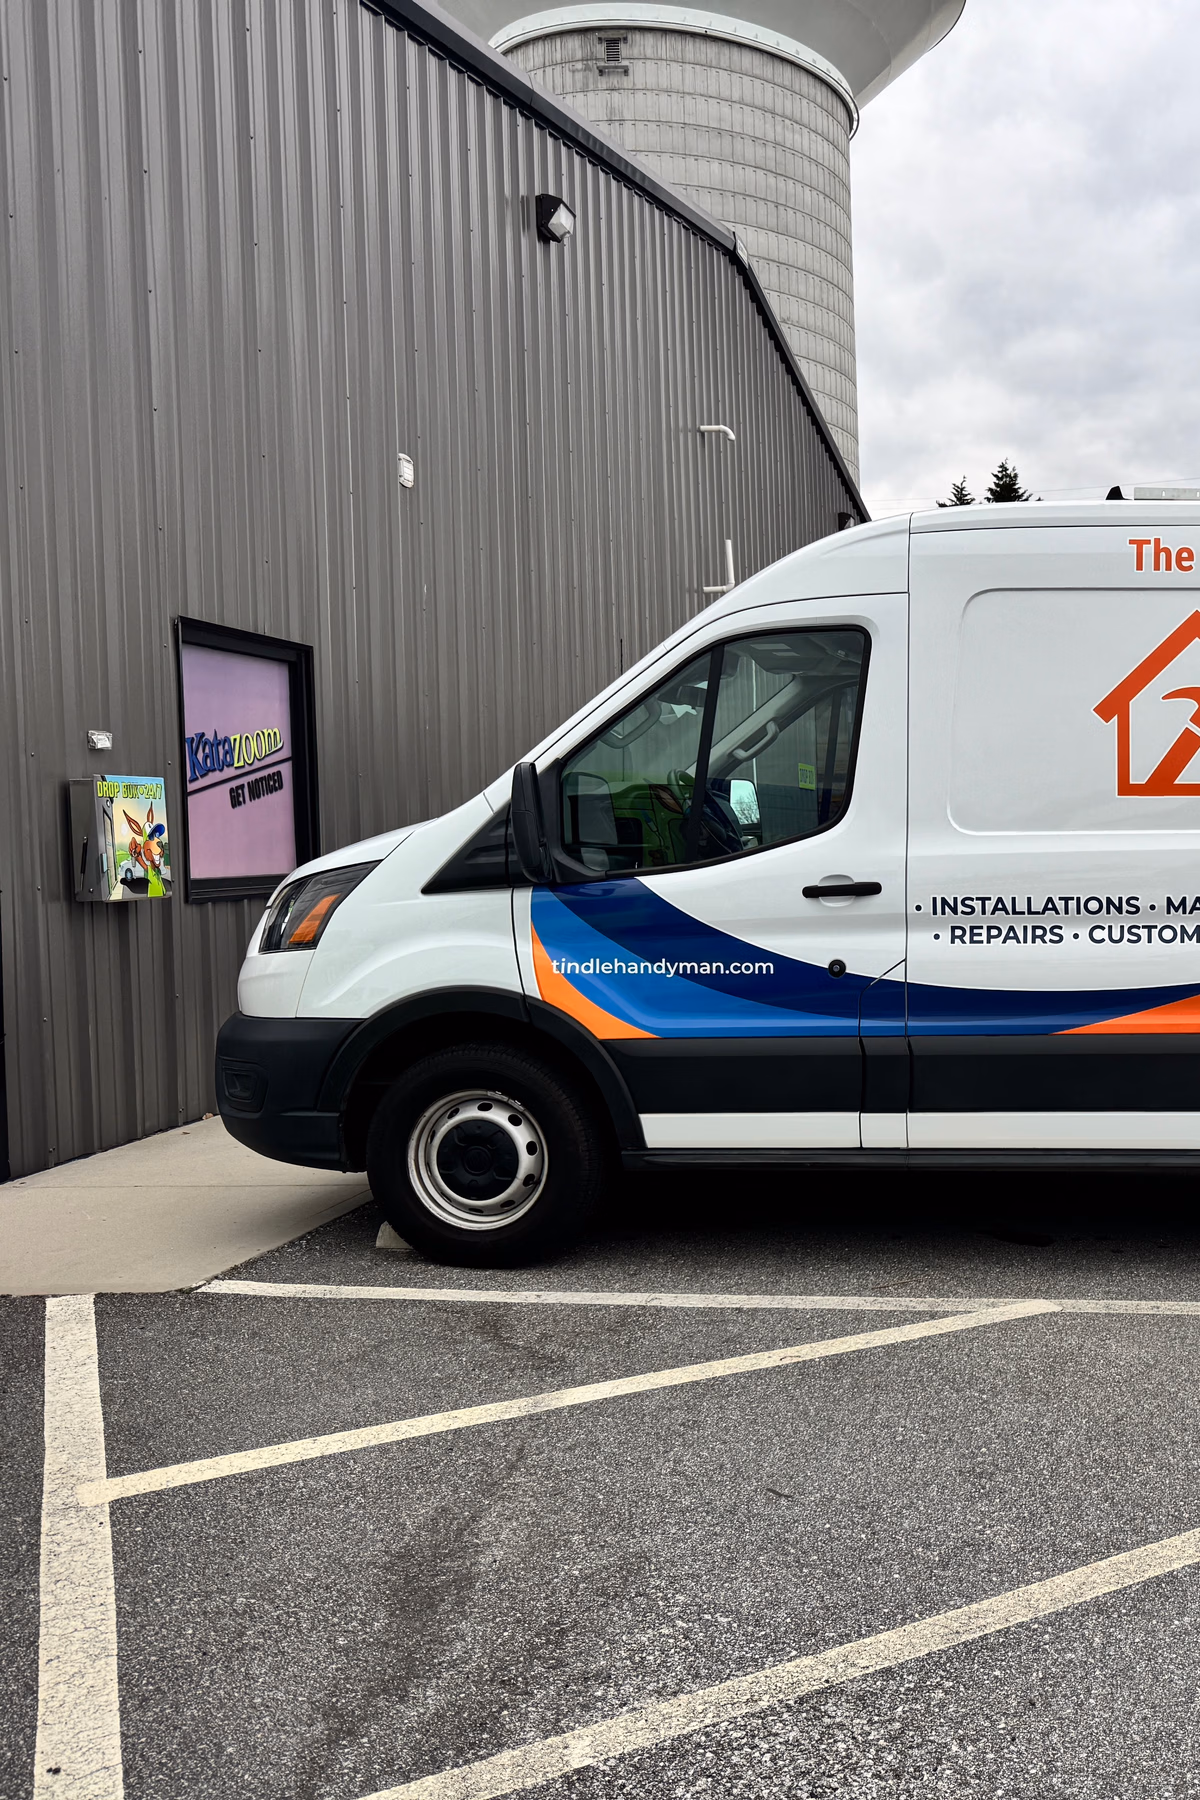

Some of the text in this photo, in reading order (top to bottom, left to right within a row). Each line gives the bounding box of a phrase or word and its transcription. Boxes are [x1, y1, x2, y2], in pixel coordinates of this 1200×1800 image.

[1129, 538, 1194, 572] The
[96, 781, 120, 798] DROP
[229, 770, 284, 809] GET NOTICED
[932, 896, 1141, 916] INSTALLATIONS
[950, 925, 1064, 945] REPAIRS
[1088, 924, 1200, 944] CUSTOM
[551, 958, 774, 977] tindlehandyman.com
